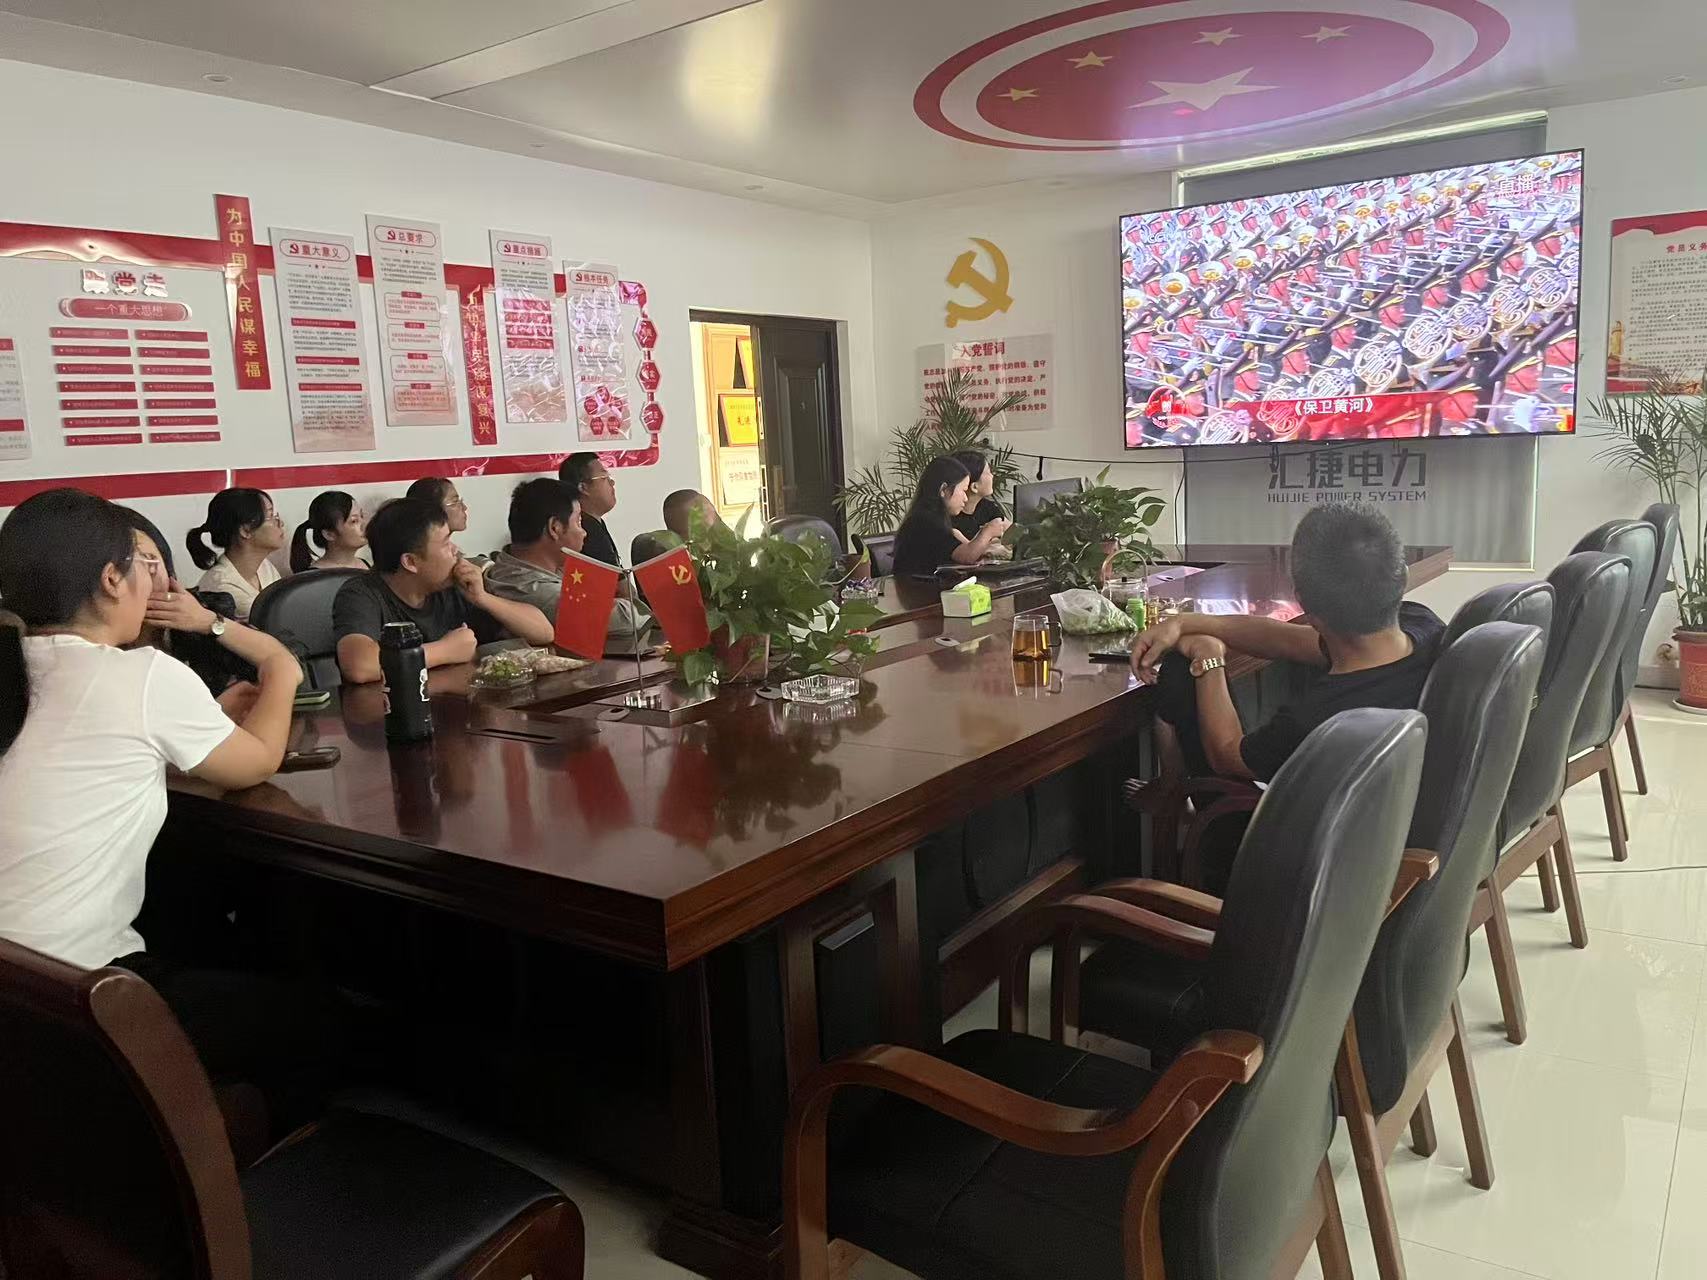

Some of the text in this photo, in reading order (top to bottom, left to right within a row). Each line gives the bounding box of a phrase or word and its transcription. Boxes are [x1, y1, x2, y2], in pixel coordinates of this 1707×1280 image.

[302, 244, 341, 259] 重大意义
[226, 208, 261, 378] 为中国人民谋幸福
[95, 303, 164, 317] 一个重大思想
[961, 342, 1006, 358] 入党誓词
[1295, 398, 1374, 416] 《保卫黄河》
[1269, 449, 1427, 489] 汇捷电力
[1268, 490, 1427, 503] HUIJIE POWER SYSTEM
